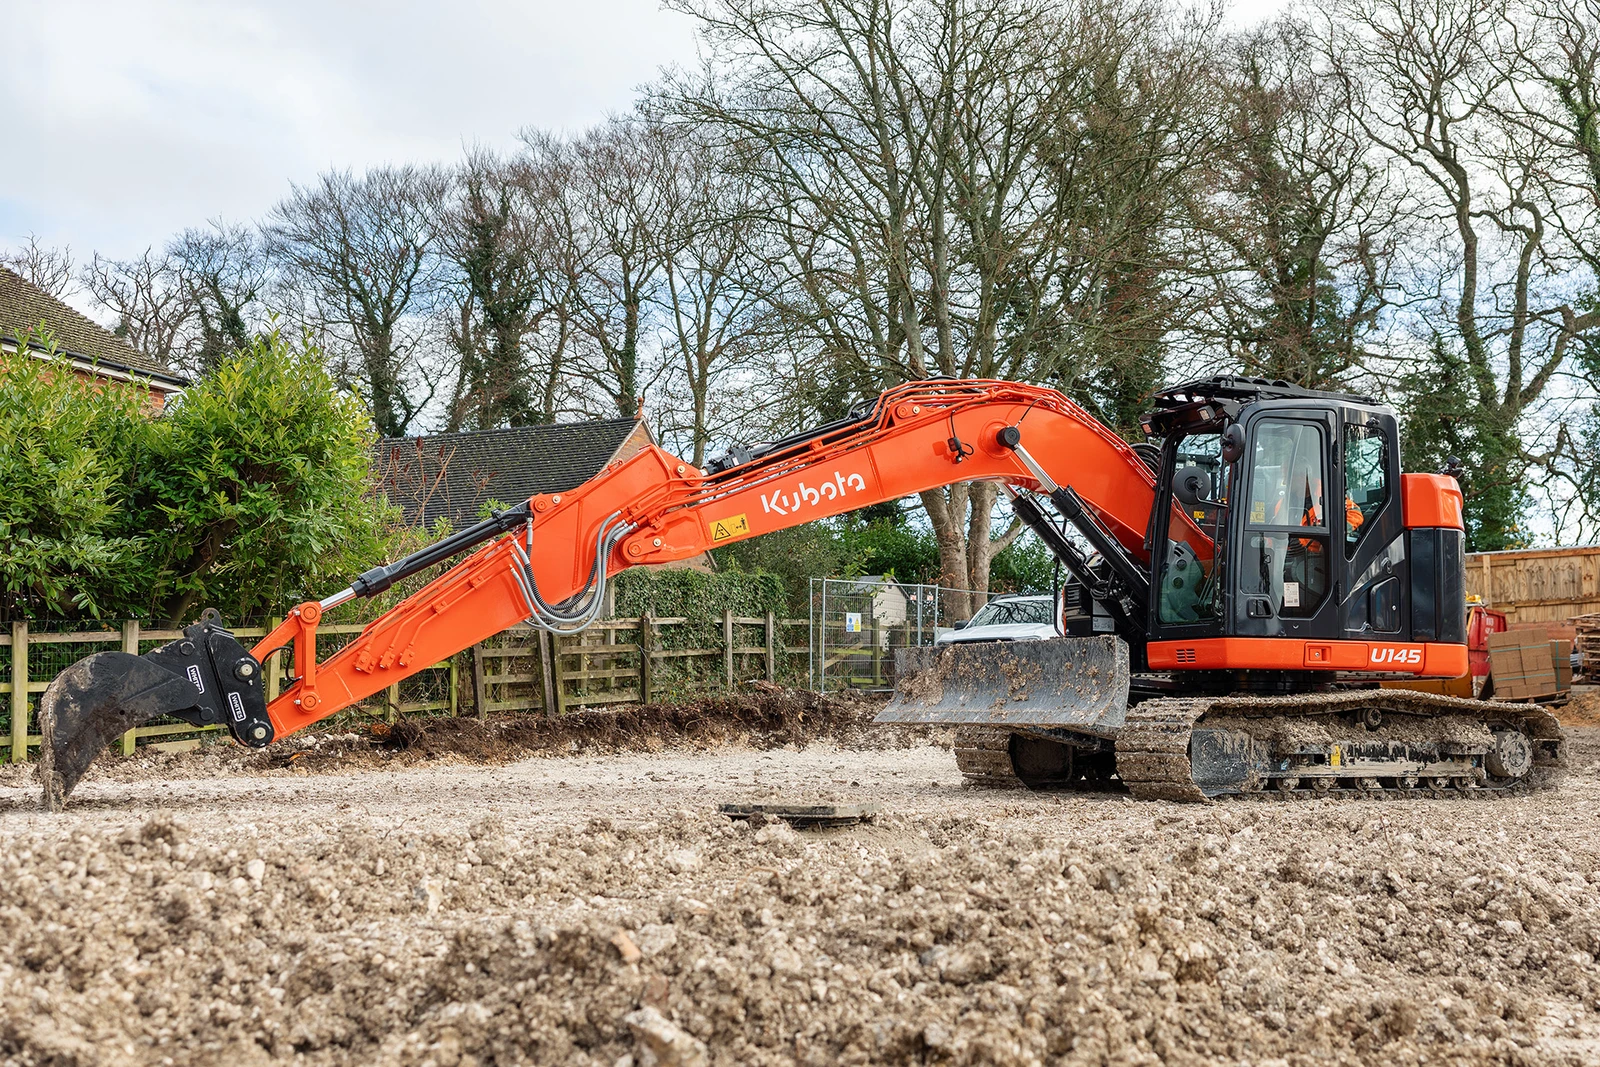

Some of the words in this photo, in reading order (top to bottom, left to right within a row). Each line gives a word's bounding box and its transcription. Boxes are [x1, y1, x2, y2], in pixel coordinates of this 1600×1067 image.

[760, 471, 866, 516] Kubota
[1371, 648, 1422, 664] U145
[231, 695, 244, 719] WHITES
